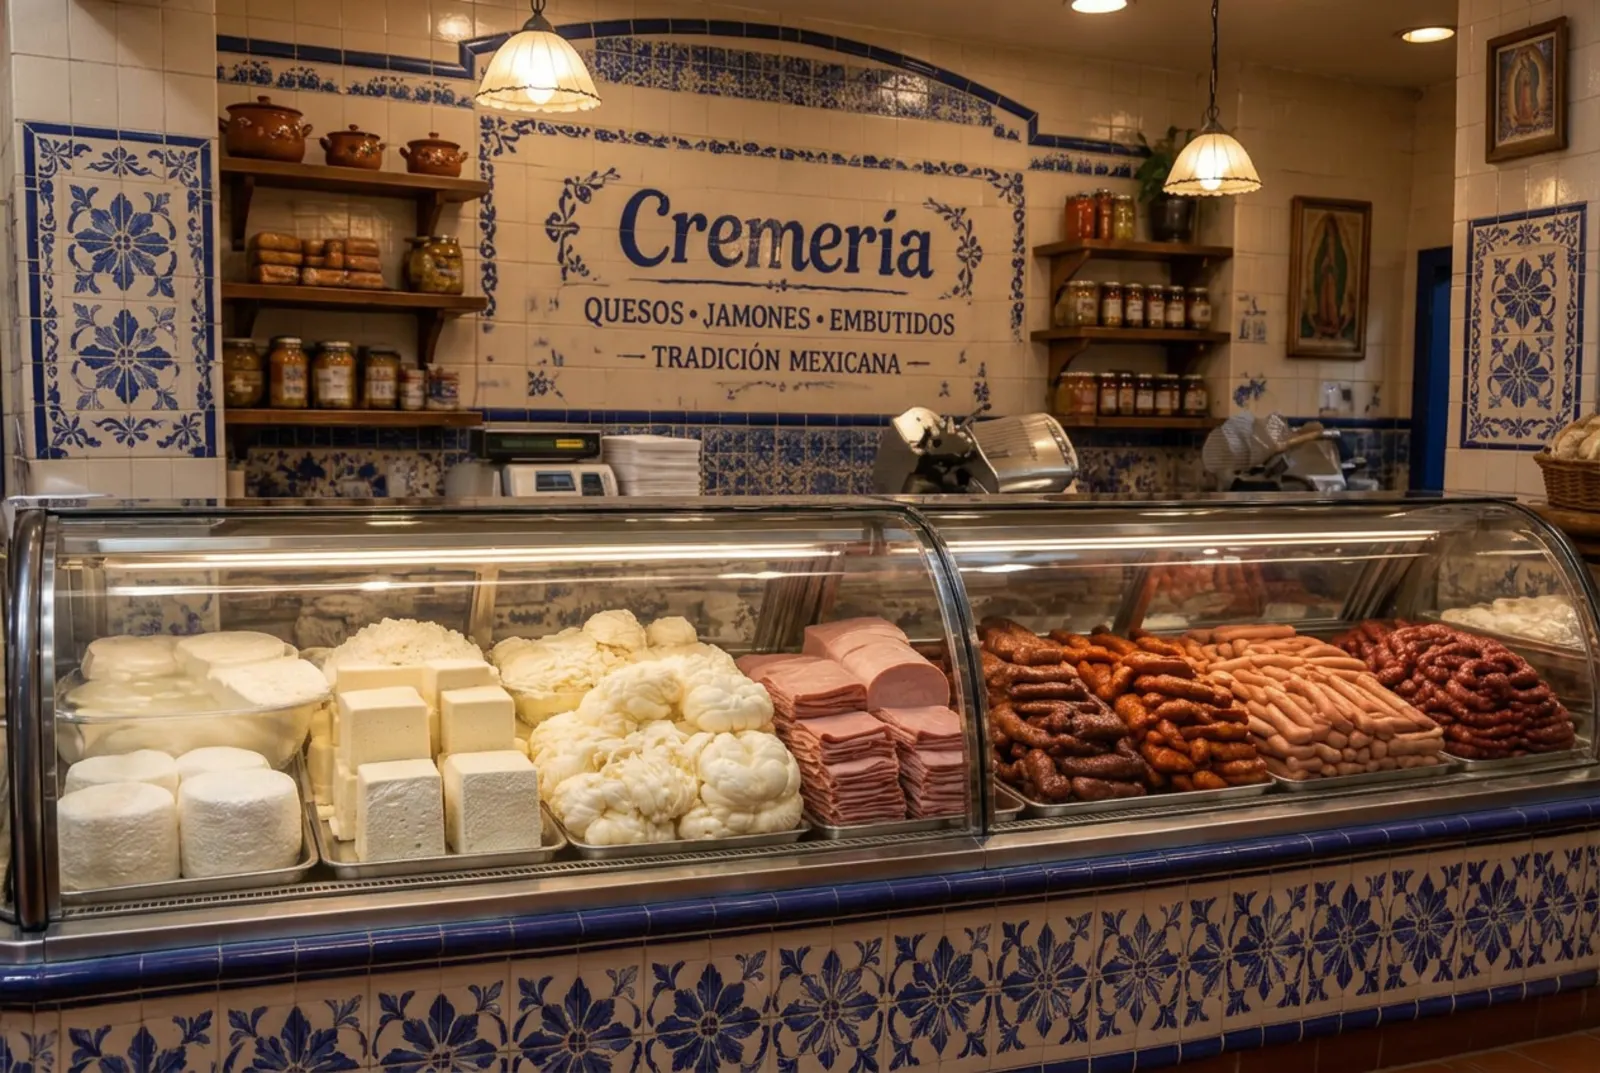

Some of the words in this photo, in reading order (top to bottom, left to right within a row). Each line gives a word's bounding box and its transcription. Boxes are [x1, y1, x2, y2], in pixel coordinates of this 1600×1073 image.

[619, 188, 934, 280] Cremería
[585, 296, 684, 329] QUESOS
[702, 302, 811, 331] JAMONES
[830, 308, 955, 337] EMBUTIDOS
[652, 342, 780, 372] TRADICIÓN
[789, 350, 902, 376] MEXICANA
